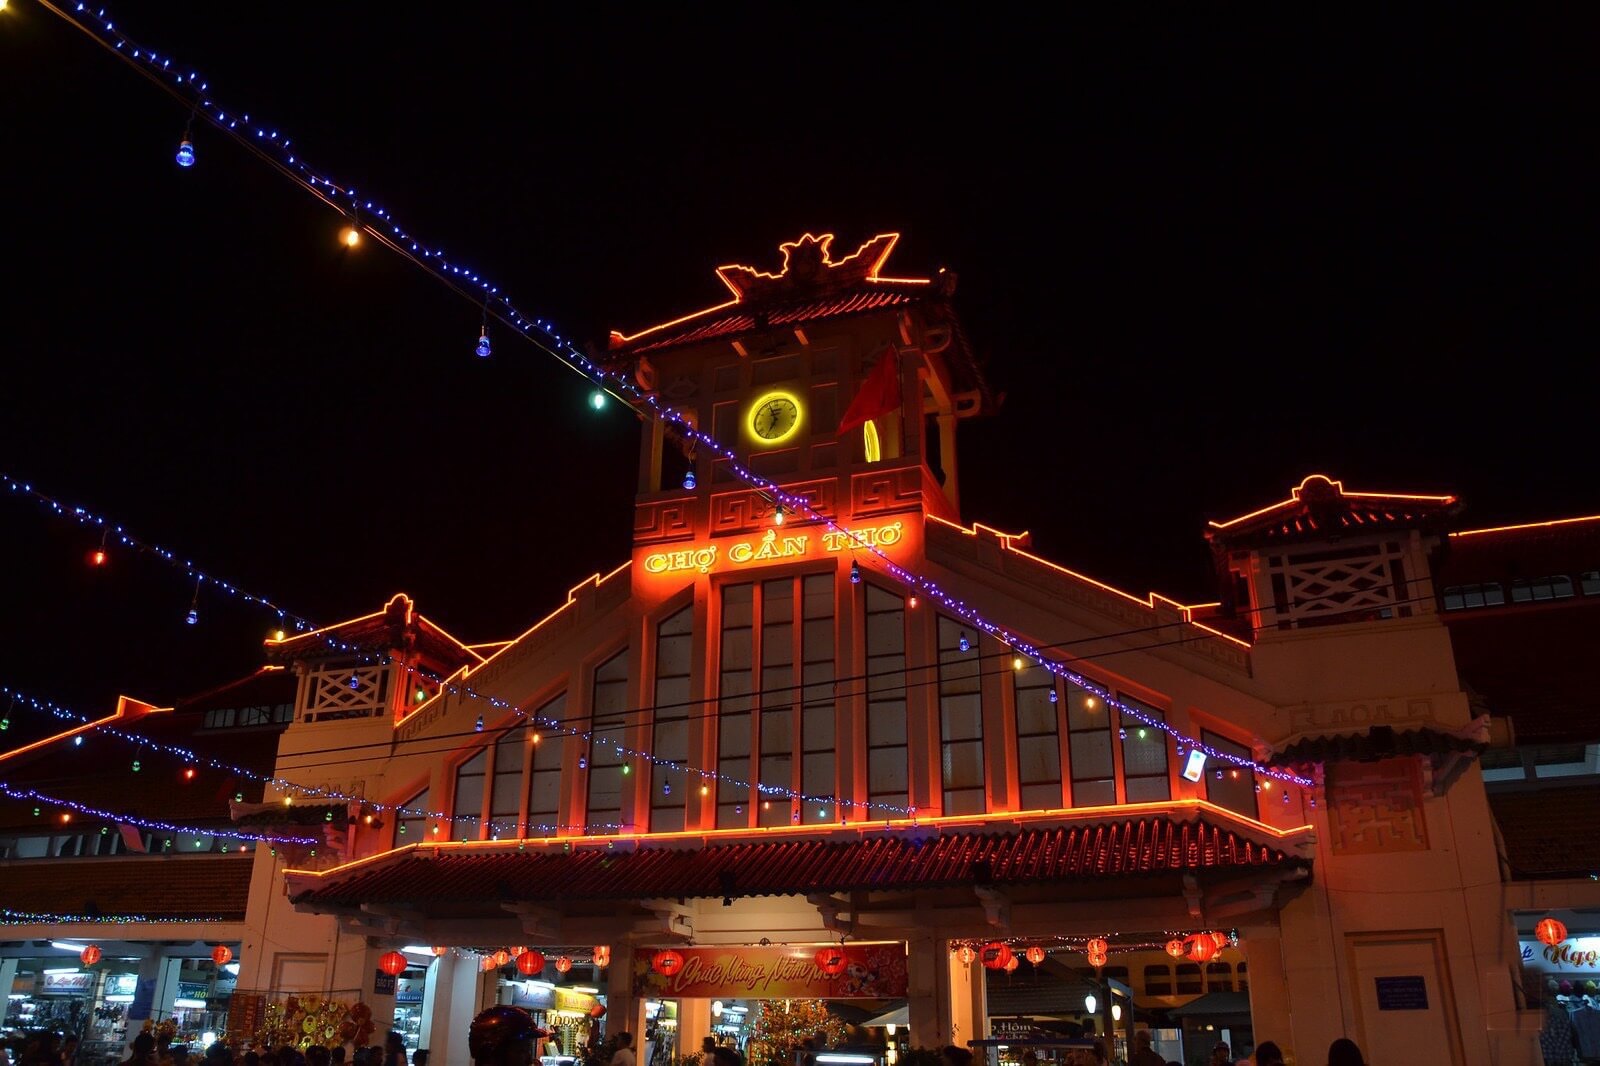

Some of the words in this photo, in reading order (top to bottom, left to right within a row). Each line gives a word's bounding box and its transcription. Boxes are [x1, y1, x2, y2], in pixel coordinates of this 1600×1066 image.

[645, 546, 716, 573] CHỢ
[729, 529, 807, 562] CẦN
[822, 522, 902, 551] THƠ
[674, 956, 722, 993] Chúc
[762, 955, 810, 991] Năm
